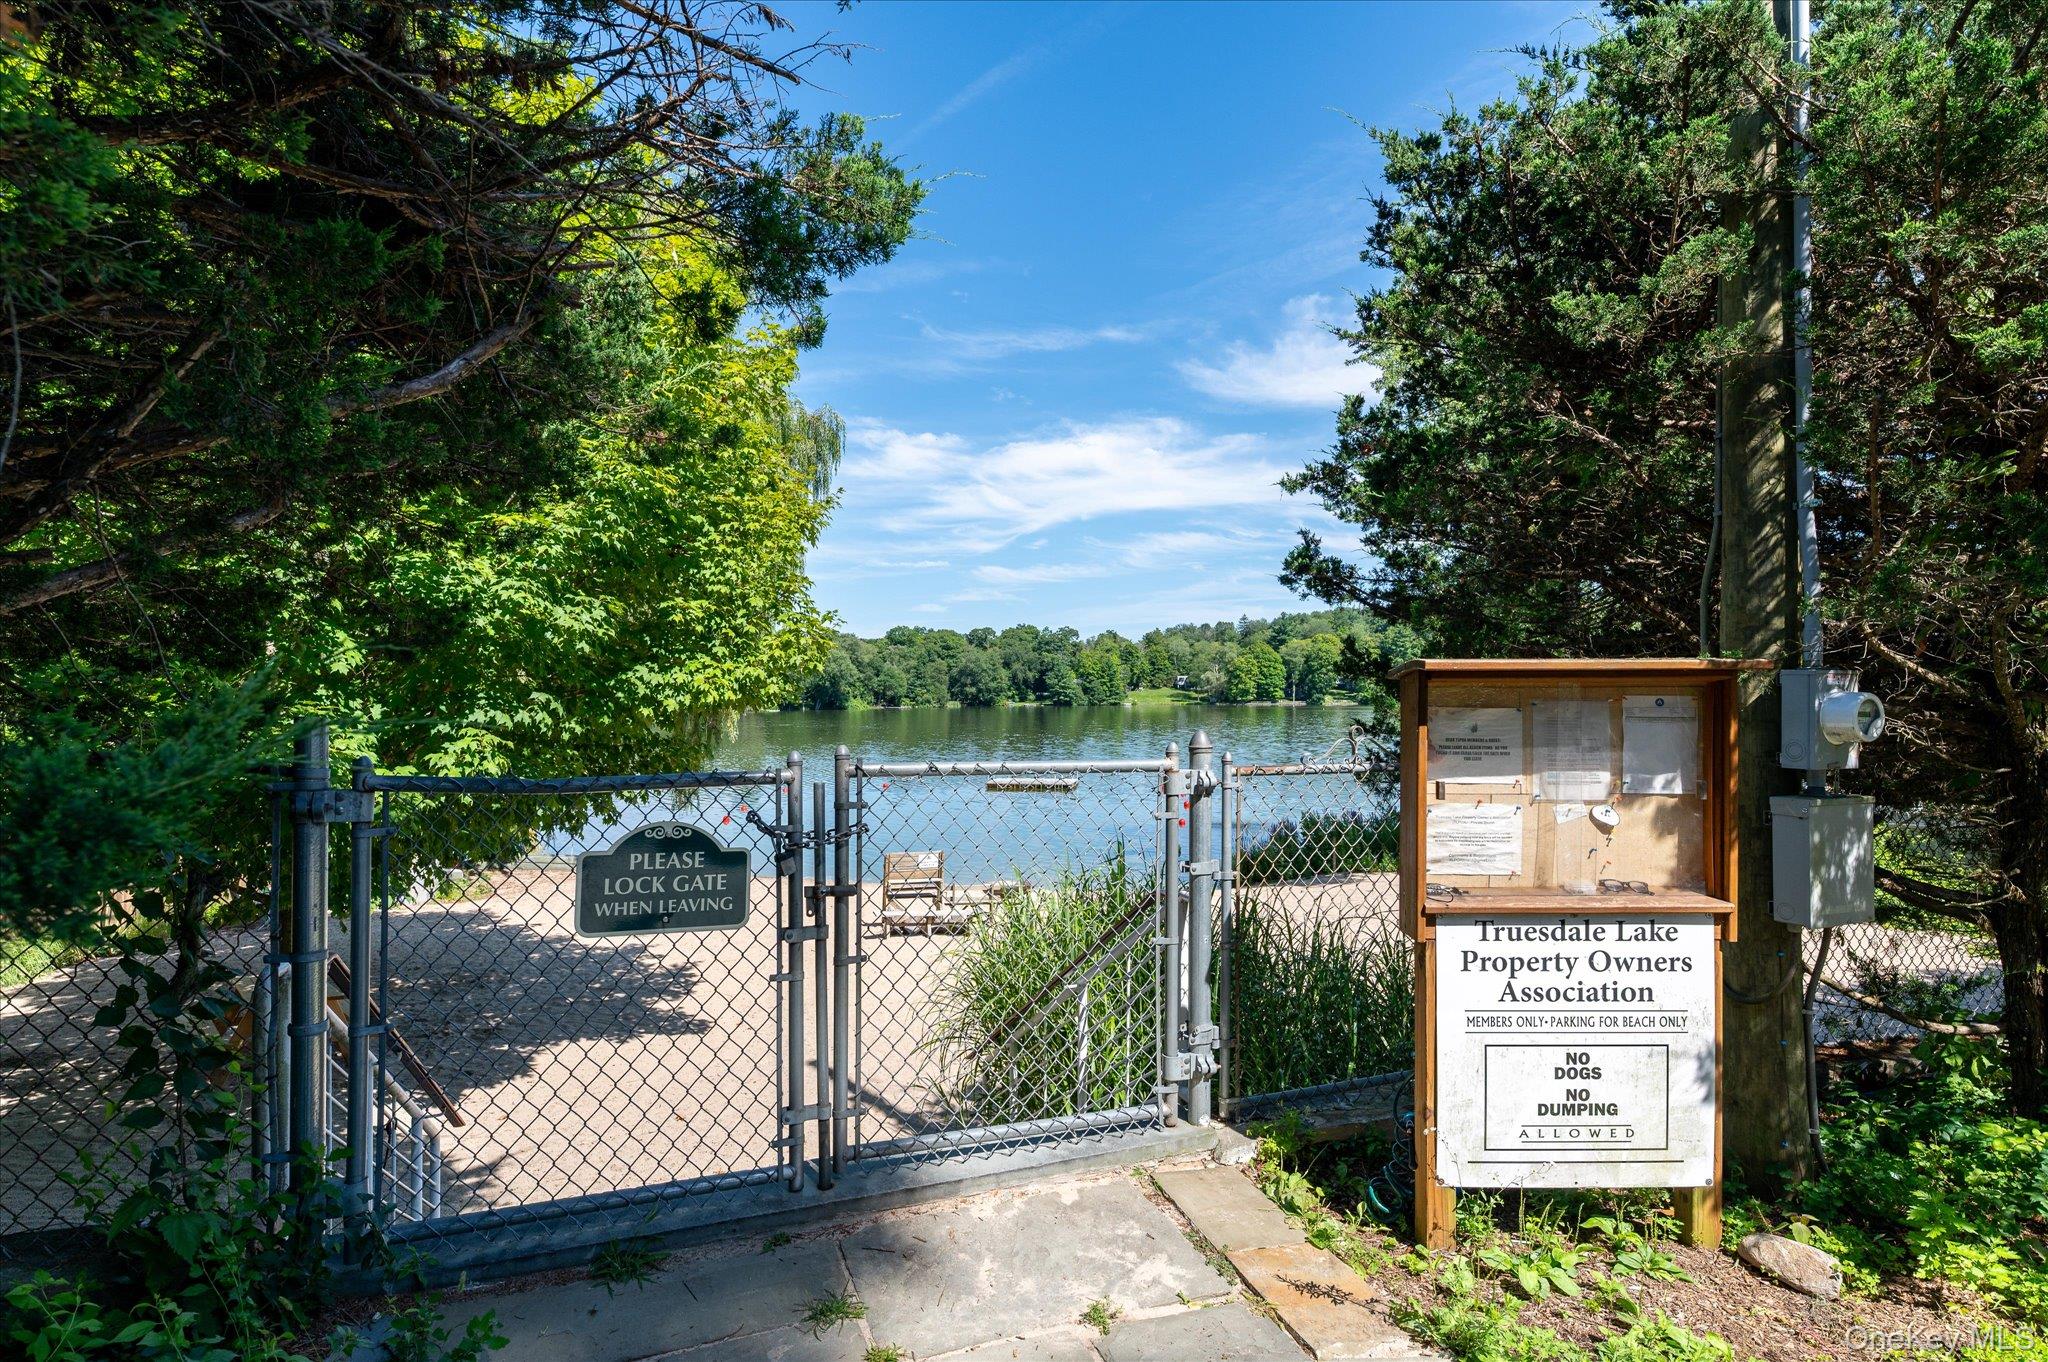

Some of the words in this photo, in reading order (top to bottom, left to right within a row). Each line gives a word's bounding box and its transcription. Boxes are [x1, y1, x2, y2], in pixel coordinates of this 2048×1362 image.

[629, 851, 705, 871] PLEASE
[604, 876, 666, 896] LOCK
[672, 873, 728, 893] GATE
[594, 901, 652, 918] WHEN
[659, 896, 734, 914] LEAVING
[1475, 919, 1606, 942] Truesdale
[1614, 919, 1679, 942] Lake
[1460, 950, 1580, 980] Property
[1588, 949, 1693, 973] Owners
[1497, 980, 1655, 1003] Association
[1466, 1015, 1513, 1028] MEMBERS
[1599, 1015, 1619, 1028] FOR
[1622, 1015, 1656, 1028] BEACH
[1659, 1015, 1688, 1029] ONLY
[1565, 1052, 1591, 1066] NO
[1554, 1066, 1602, 1080] DOGS
[1565, 1088, 1591, 1102] NO
[1537, 1102, 1618, 1117] DUMPING
[1519, 1128, 1635, 1139] ALLOWED
